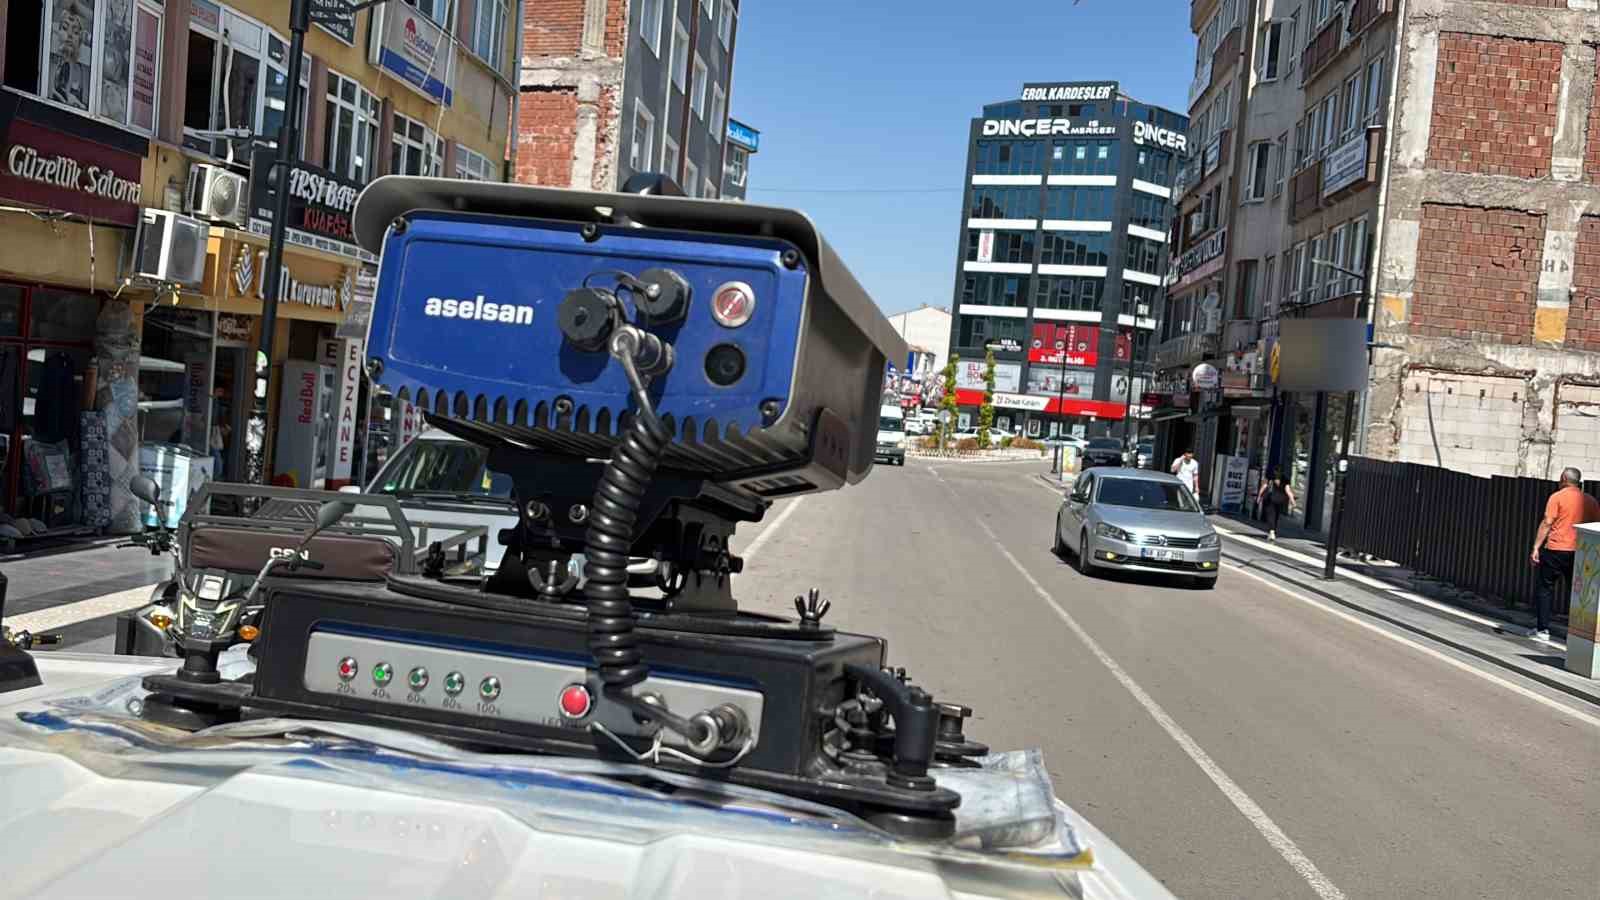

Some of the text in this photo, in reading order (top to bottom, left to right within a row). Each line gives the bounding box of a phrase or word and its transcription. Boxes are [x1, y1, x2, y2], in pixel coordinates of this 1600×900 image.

[1022, 87, 1047, 101] EROL
[8, 144, 141, 203] Güzellik Salonu
[424, 295, 534, 325] aselsan
[339, 345, 358, 463] ECZANE
